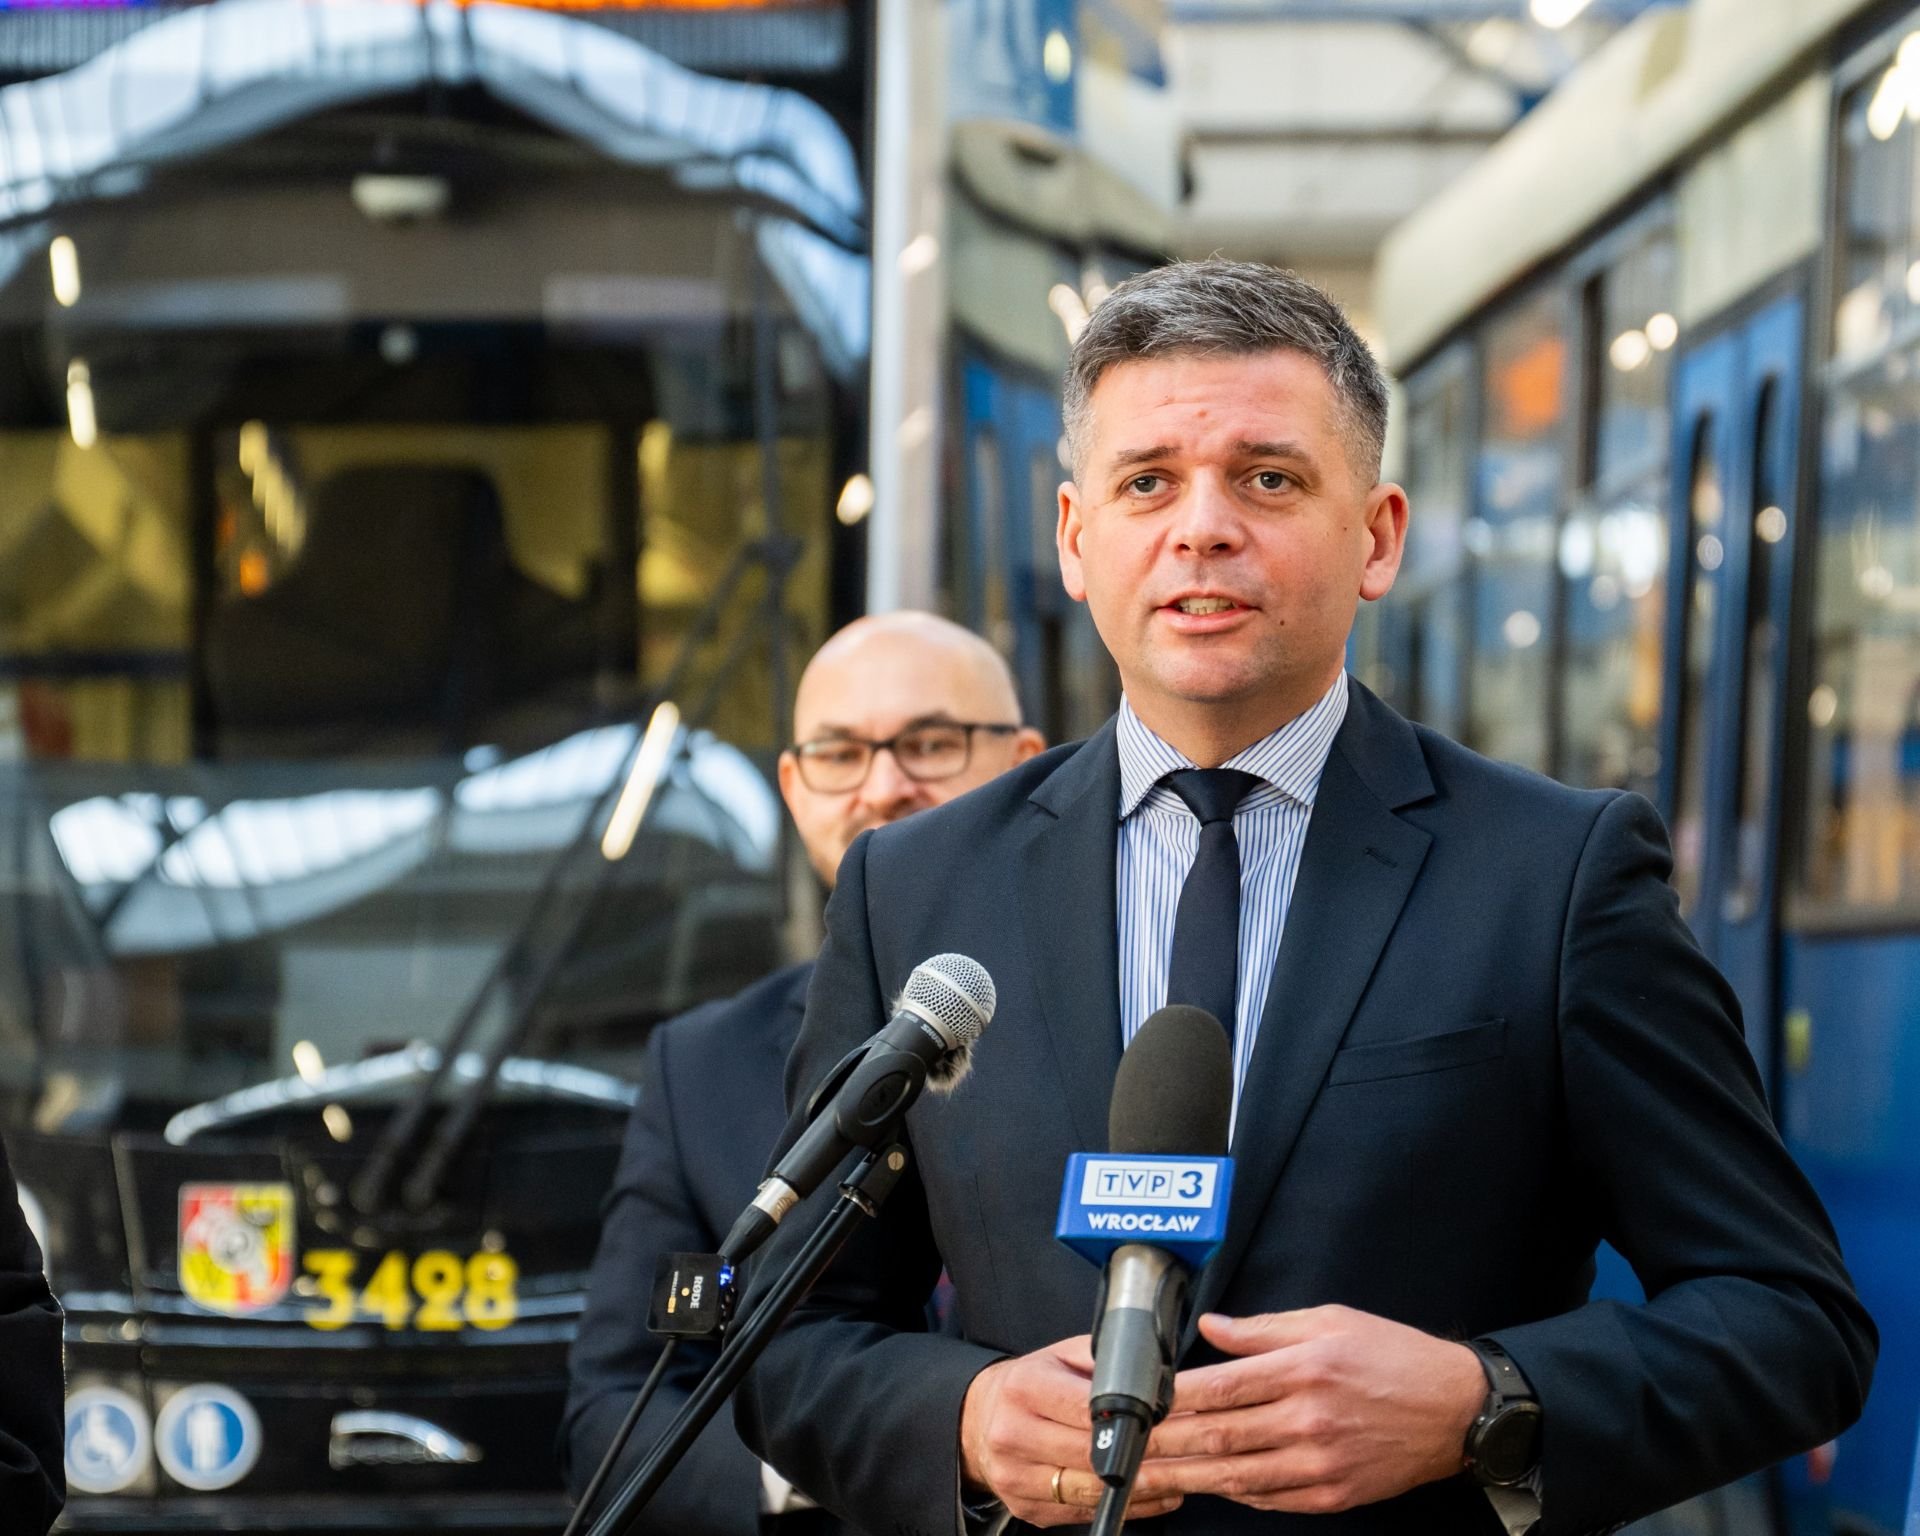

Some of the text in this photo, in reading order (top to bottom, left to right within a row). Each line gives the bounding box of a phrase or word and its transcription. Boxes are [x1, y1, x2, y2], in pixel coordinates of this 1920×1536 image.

[1103, 1170, 1203, 1199] TVP 3
[1088, 1212, 1200, 1232] WROCŁAW
